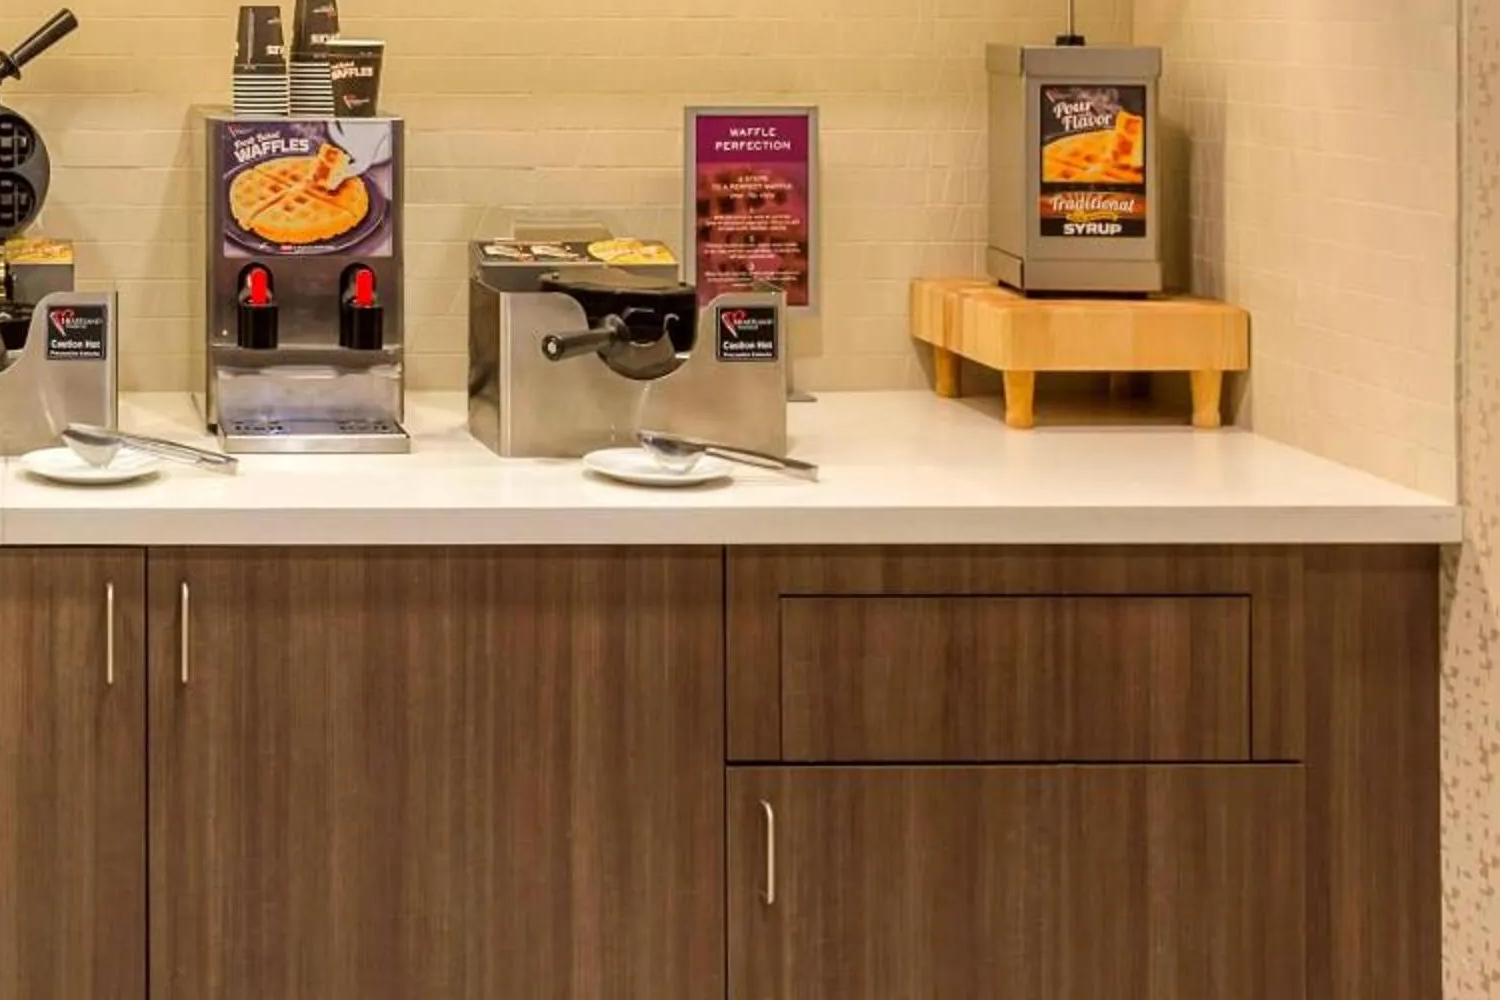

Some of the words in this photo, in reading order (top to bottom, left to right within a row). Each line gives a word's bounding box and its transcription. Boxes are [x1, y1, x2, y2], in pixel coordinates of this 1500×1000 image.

[1053, 101, 1093, 119] Pour
[1061, 113, 1113, 132] Flavor
[729, 127, 778, 137] WAFFLE
[234, 138, 310, 162] WAFFLES
[714, 140, 791, 151] PERFECTION
[1050, 195, 1135, 214] Traditional
[1063, 222, 1123, 235] SYRUP
